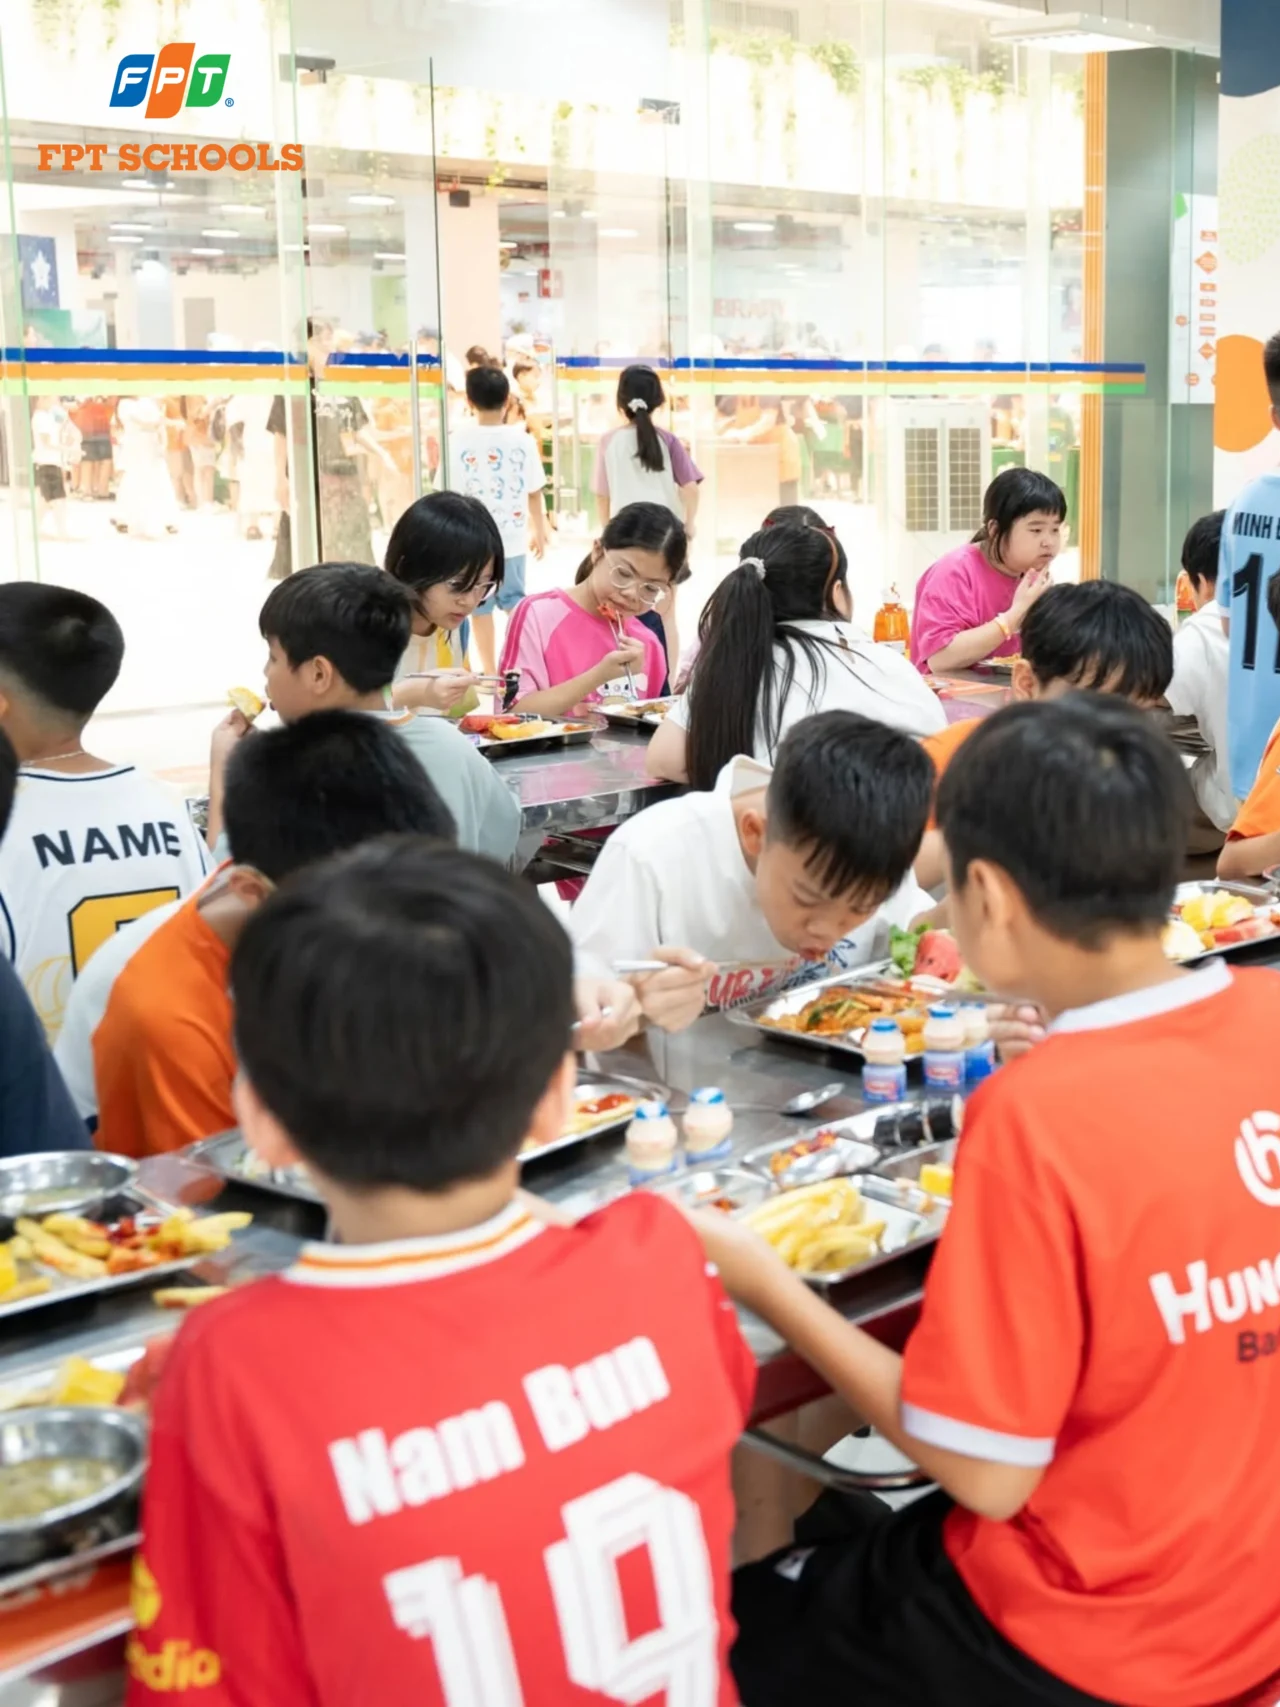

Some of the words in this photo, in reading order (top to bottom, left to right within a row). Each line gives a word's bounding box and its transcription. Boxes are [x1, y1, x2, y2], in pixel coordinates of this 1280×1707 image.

[1231, 512, 1273, 540] MINH
[32, 820, 182, 870] NAME
[327, 1399, 527, 1528] Nam
[520, 1334, 673, 1454] Bun
[382, 1471, 721, 1707] 19
